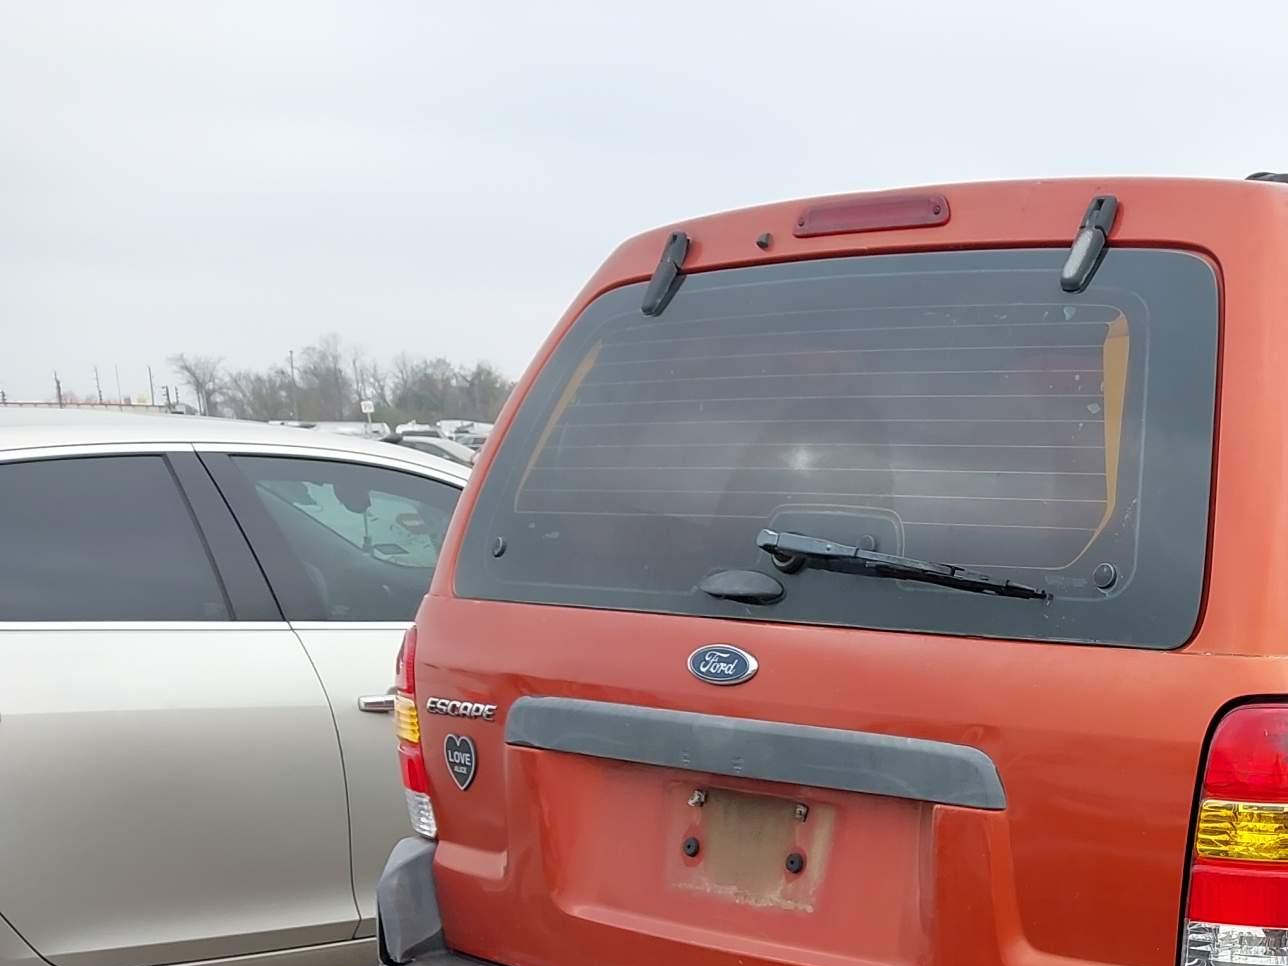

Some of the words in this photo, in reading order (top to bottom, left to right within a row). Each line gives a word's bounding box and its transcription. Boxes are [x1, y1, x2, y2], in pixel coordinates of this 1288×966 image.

[699, 650, 738, 675] Ford
[426, 697, 497, 721] ESCAPE
[447, 749, 472, 766] LOVE
